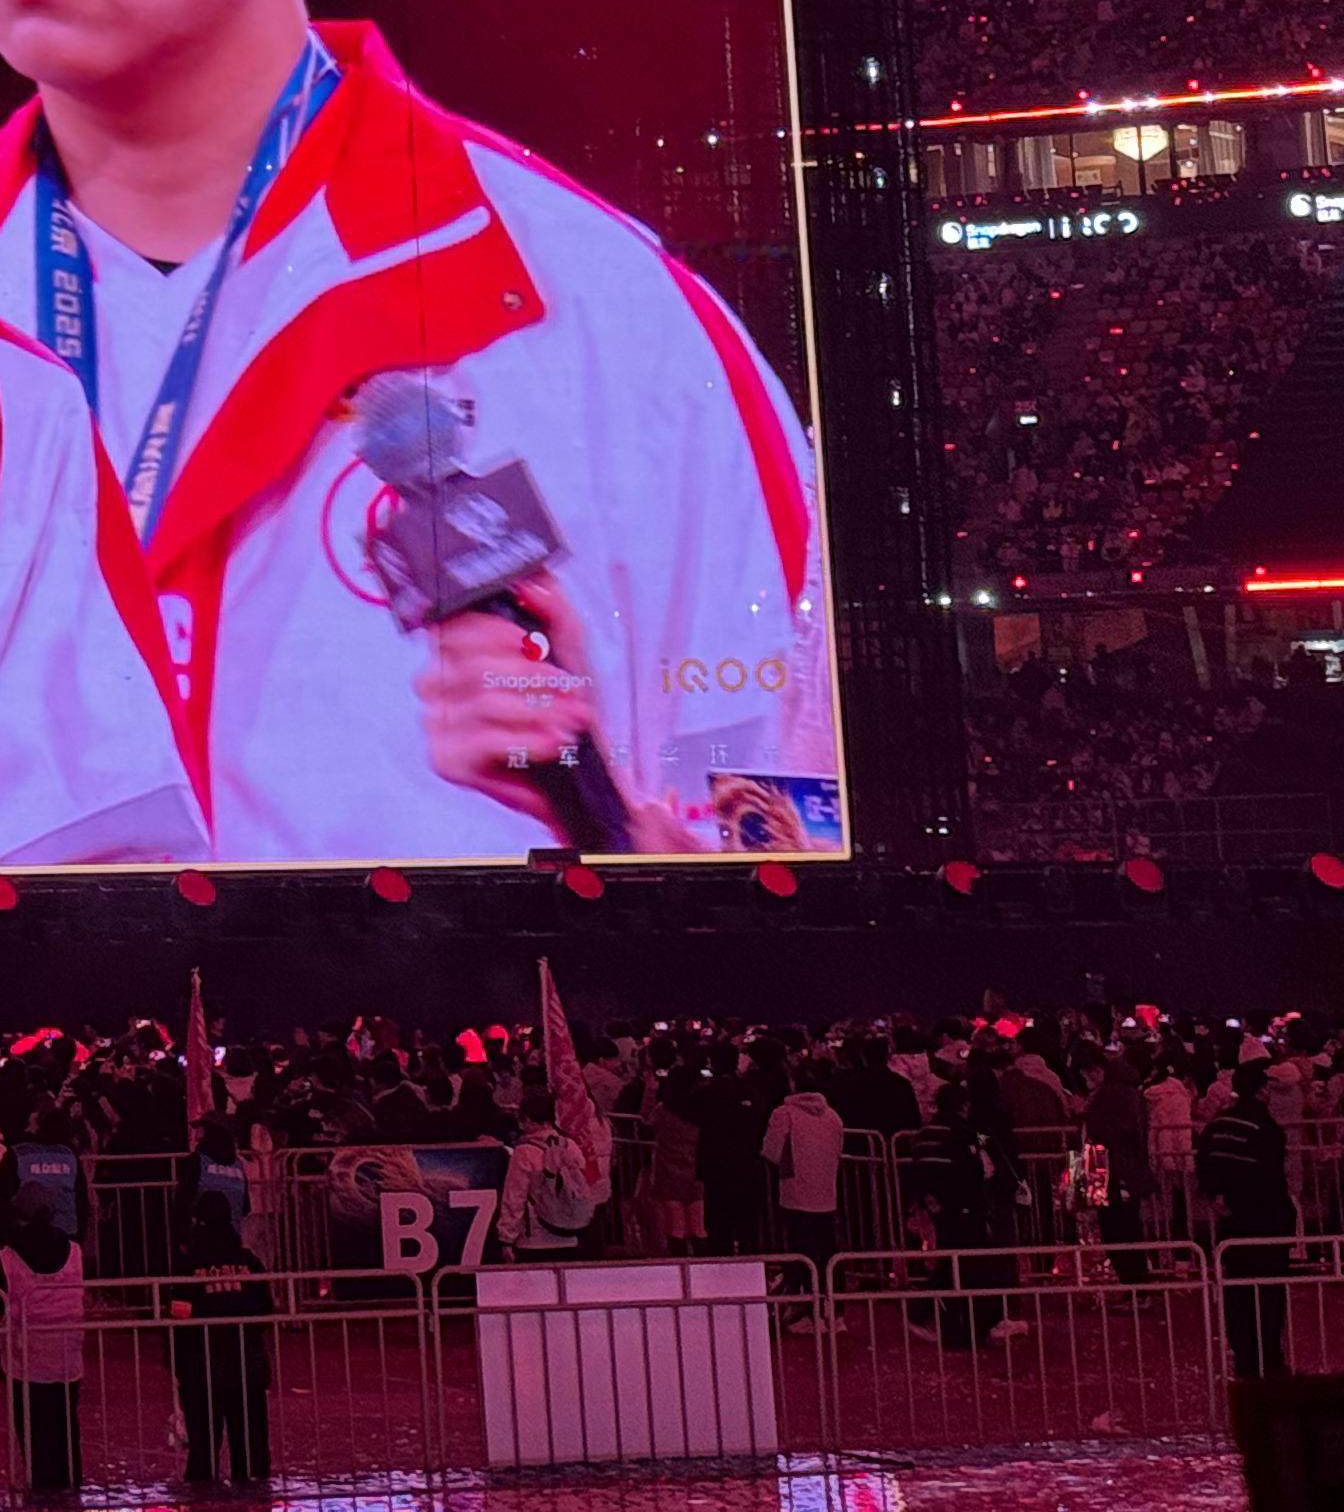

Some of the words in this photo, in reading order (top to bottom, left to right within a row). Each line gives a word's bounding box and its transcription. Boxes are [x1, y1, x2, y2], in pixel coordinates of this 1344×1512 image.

[52, 268, 83, 359] 2025
[482, 671, 593, 694] Snapdragon
[662, 657, 787, 694] iQOO
[380, 1189, 498, 1273] B7
